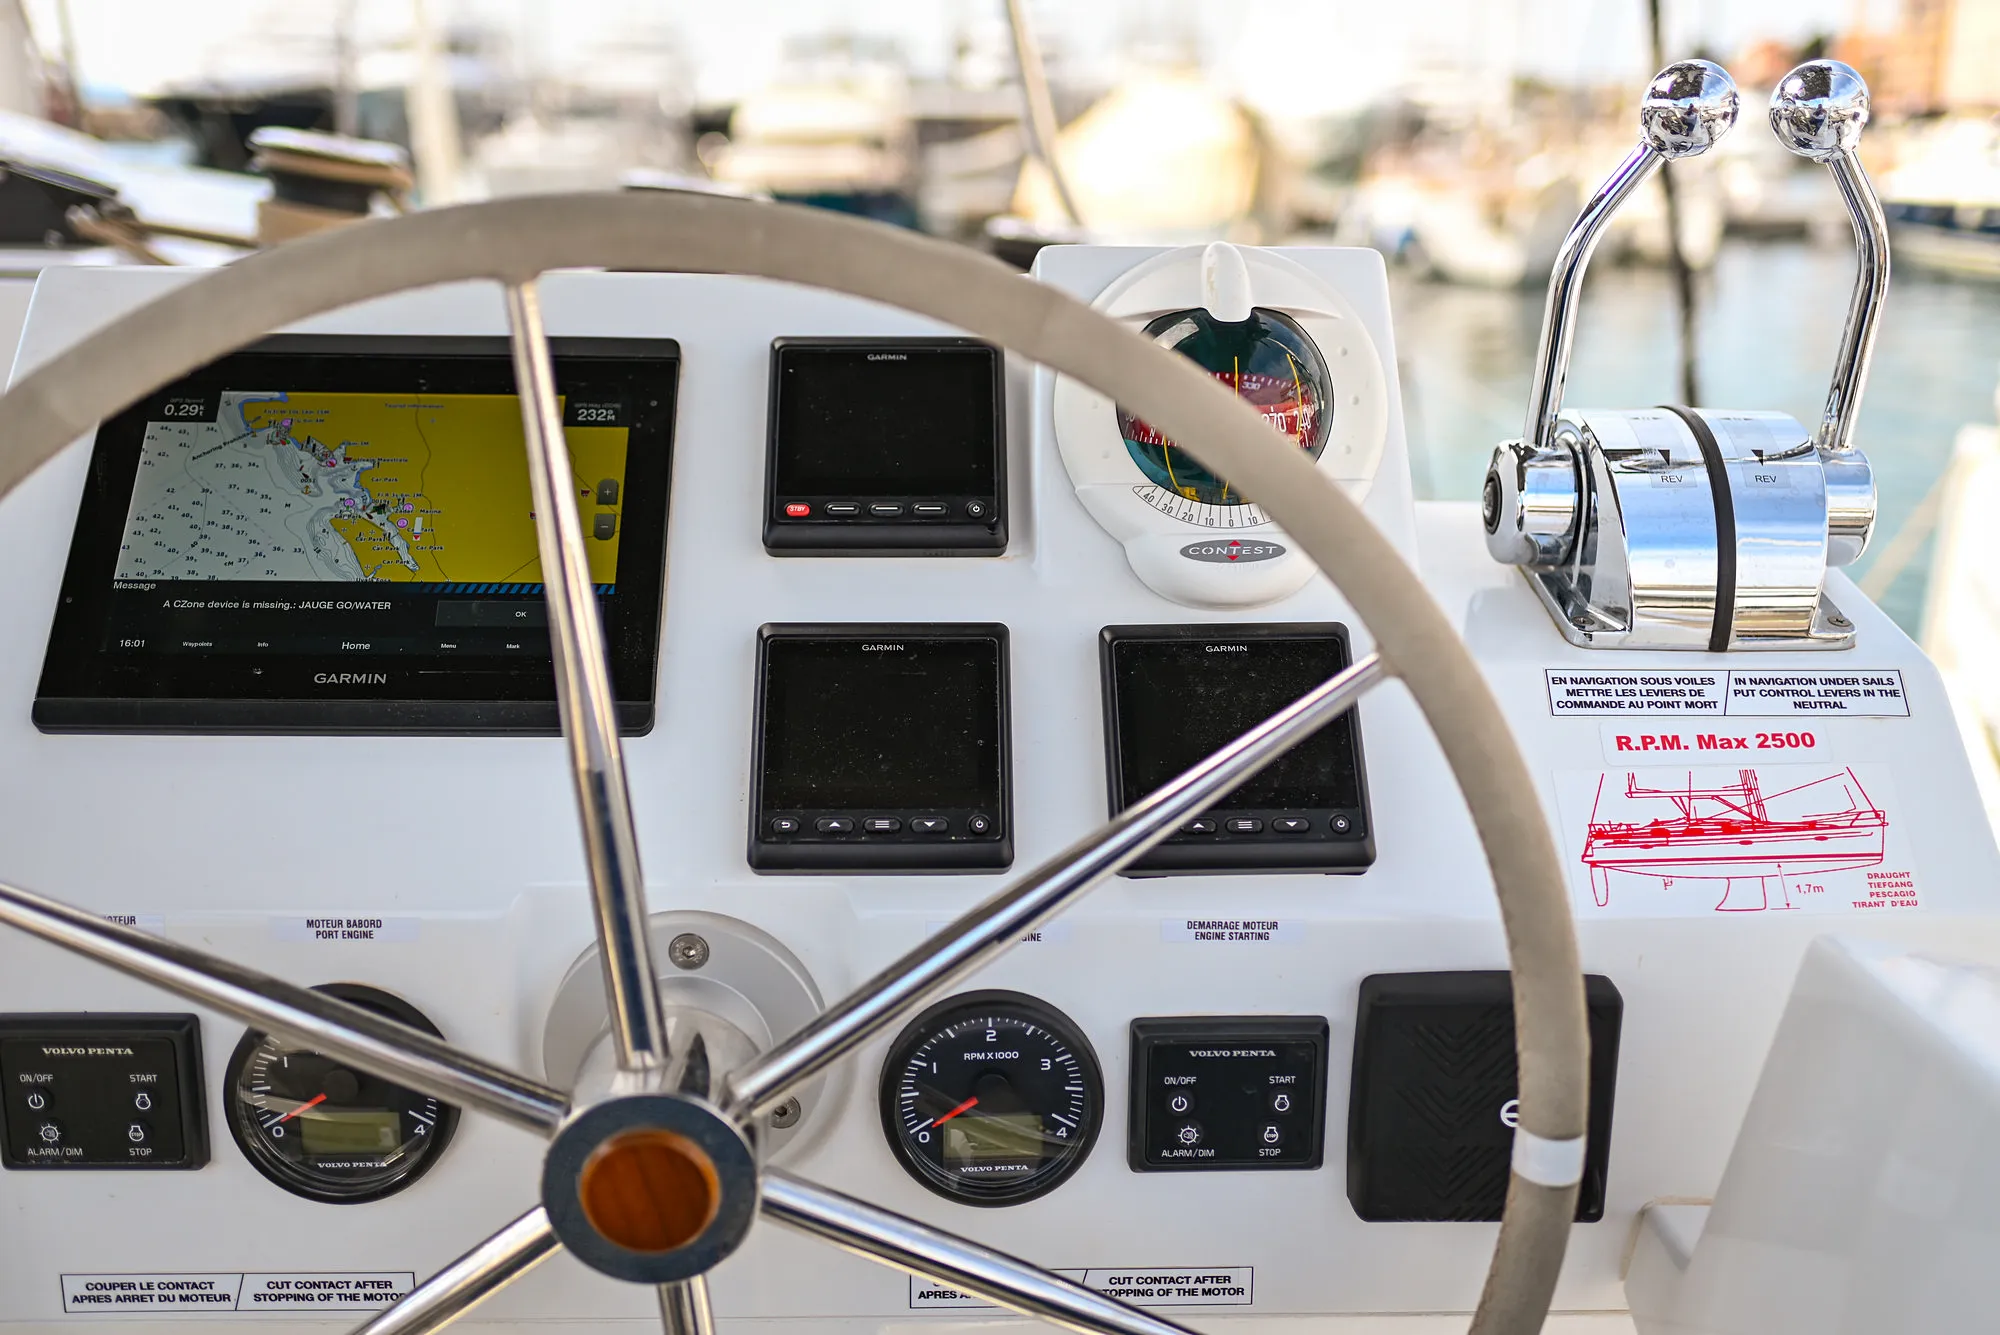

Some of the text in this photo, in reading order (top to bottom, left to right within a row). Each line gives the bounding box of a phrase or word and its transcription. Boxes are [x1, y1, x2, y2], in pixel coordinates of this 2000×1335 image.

[867, 353, 907, 361] GARMIN
[164, 404, 199, 416] 0.29
[577, 408, 607, 421] 232
[1660, 475, 1684, 484] REV
[1754, 475, 1777, 483] REV
[1143, 492, 1155, 503] 40
[1161, 503, 1174, 514] 30
[1181, 511, 1194, 522] 20
[1204, 517, 1214, 526] 10
[1248, 516, 1258, 525] 10
[1228, 518, 1234, 527] 0
[1188, 545, 1278, 555] CONTEST
[113, 581, 157, 590] Message
[163, 600, 171, 609] A
[173, 600, 206, 609] CZone
[207, 600, 240, 609] device
[242, 601, 250, 609] is
[298, 601, 335, 610] JAUGE
[336, 601, 392, 610] GO/WATER
[119, 639, 146, 648] 16:01
[182, 641, 213, 649] Waypoints
[341, 641, 371, 650] Home
[313, 673, 387, 685] GARMIN
[1551, 677, 1716, 686] EN NAVIGATION SOUS VOILES
[1734, 677, 1895, 686] IN NAVIGATION UNDER SAILS
[1566, 688, 1706, 698] METTRE LES LEVIERS DE
[1733, 689, 1901, 698] PUT CONTROL LEVERS IN THE
[1556, 700, 1718, 709] COMMANDE AU POINT MORT
[1793, 701, 1848, 710] NEUTRAL
[1615, 732, 1816, 752] R.P.M. Max 2500
[1866, 871, 1911, 880] DRAUGHT
[1795, 883, 1825, 895] 1,7m
[1867, 880, 1914, 889] TIEFGANG
[1868, 890, 1916, 899] PESCAGIO
[1851, 899, 1918, 909] TIRANT D'EAU
[306, 918, 382, 929] MOTEUR BABORD
[1186, 921, 1279, 930] DEMARRAGE MOTEUR
[315, 929, 374, 940] PORT ENGINE
[1019, 932, 1042, 943] GINE
[1194, 931, 1270, 941] ENGINE STARTING
[985, 1030, 997, 1042] 2
[41, 1047, 134, 1055] VOLVO PENTA
[1188, 1050, 1277, 1058] VOLVO PENTA
[963, 1052, 986, 1061] RPM
[933, 1062, 938, 1074] 1
[1040, 1058, 1051, 1071] 3
[19, 1073, 54, 1083] ON/OFF
[129, 1074, 158, 1083] START
[1164, 1076, 1197, 1086] ON/OFF
[1269, 1075, 1297, 1084] START
[272, 1125, 285, 1138] 0
[414, 1124, 426, 1136] 4
[1056, 1126, 1068, 1139] 4
[918, 1131, 930, 1143] 0
[27, 1147, 83, 1157] ALARM/DIM
[129, 1148, 152, 1156] STOP
[1161, 1148, 1215, 1158] ALARM/DIM
[1258, 1148, 1282, 1157] STOP
[959, 1164, 1029, 1173] VOLVO PENTA
[266, 1280, 393, 1291] CUT CONTACT AFTER
[1108, 1275, 1232, 1286] CUT CONTACT AFTER
[85, 1280, 216, 1292] COUPER LE CONTACT
[253, 1292, 316, 1303] STOPPING
[317, 1292, 334, 1303] OF
[336, 1292, 366, 1303] THE
[918, 1289, 959, 1300] APRES
[1099, 1287, 1245, 1298] TOPPING OF THE MOTOR
[72, 1293, 232, 1305] APRES ARRET DU MOTEUR
